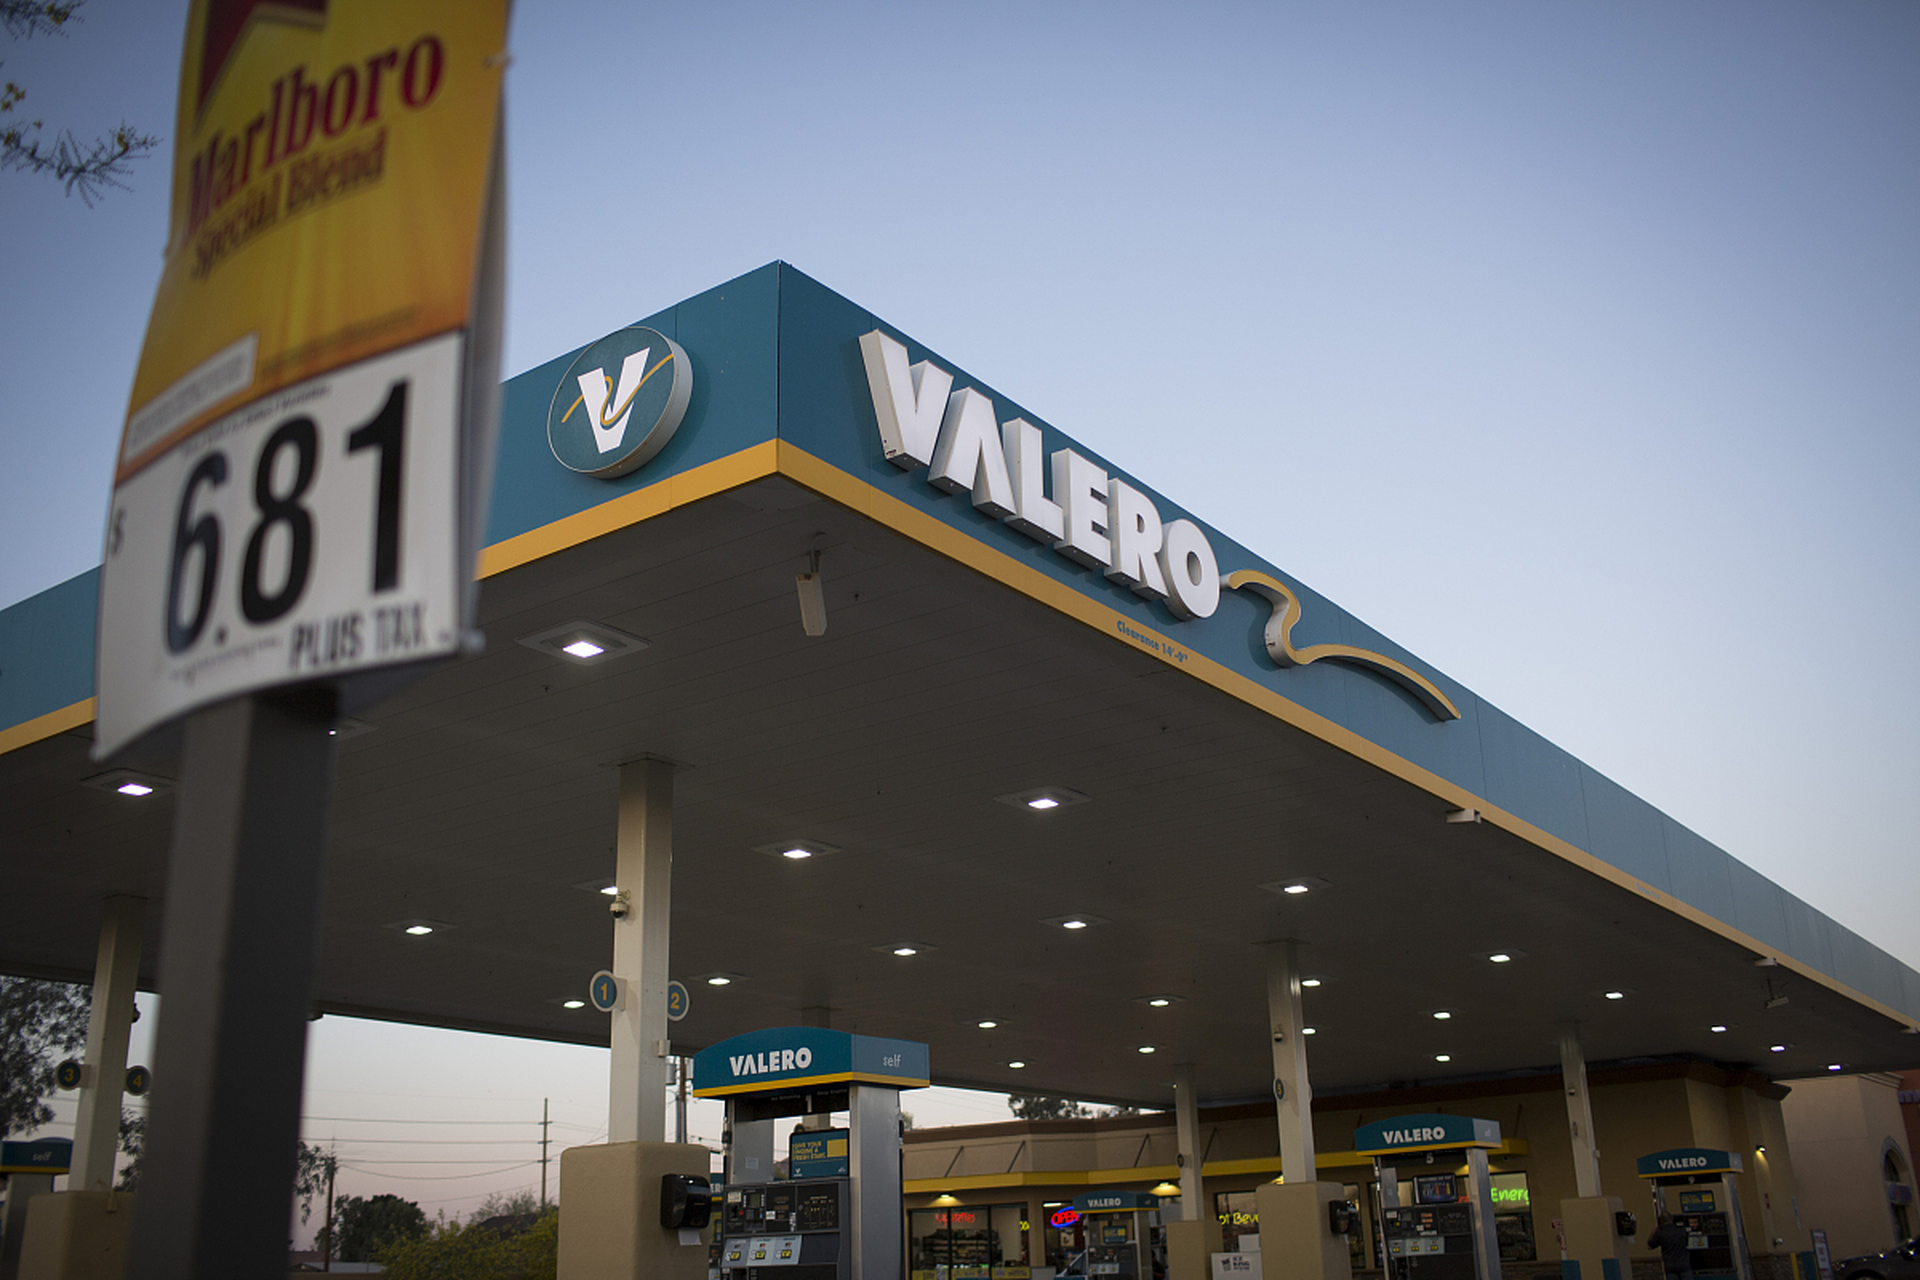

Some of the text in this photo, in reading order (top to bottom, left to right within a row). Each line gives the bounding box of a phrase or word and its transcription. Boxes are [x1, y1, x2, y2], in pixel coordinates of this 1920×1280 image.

[188, 33, 445, 242] Marlboro
[859, 329, 1220, 621] VALERO
[289, 610, 364, 674] PLUS
[371, 600, 429, 655] TAX
[1117, 620, 1159, 651] Clearance
[601, 982, 608, 1001] 1
[670, 992, 680, 1010] 2
[729, 1046, 812, 1077] VALERO
[882, 1053, 901, 1068] self
[64, 1067, 74, 1082] 3
[132, 1074, 142, 1088] 4
[1383, 1126, 1445, 1144] VALERO
[32, 1151, 52, 1162] self
[1426, 1152, 1434, 1164] 5
[1659, 1156, 1708, 1170] VALERO
[1087, 1197, 1122, 1208] VALERO
[1051, 1210, 1079, 1225] OPEN
